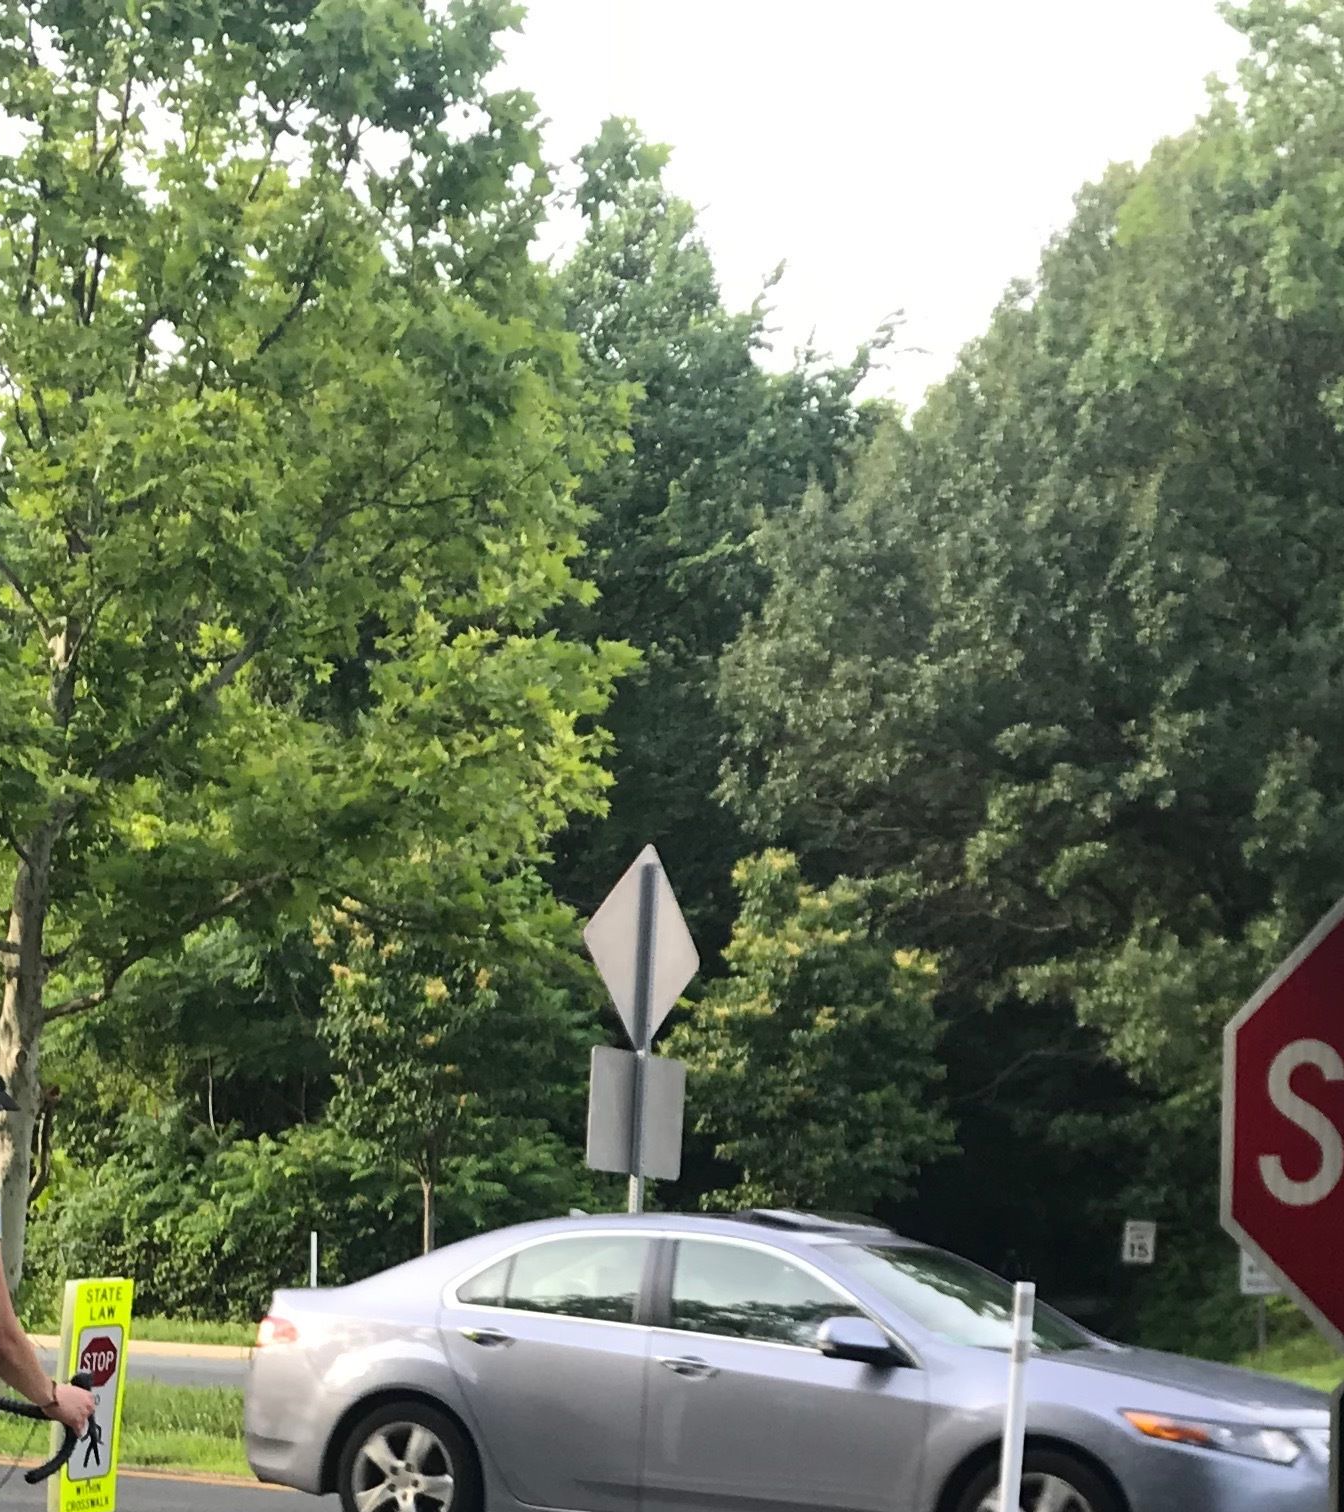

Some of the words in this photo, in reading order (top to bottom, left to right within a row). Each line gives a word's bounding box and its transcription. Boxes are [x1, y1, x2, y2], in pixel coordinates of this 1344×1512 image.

[1129, 1242, 1150, 1258] 15
[86, 1286, 123, 1303] STATE
[89, 1306, 116, 1321] LAW
[82, 1350, 115, 1373] STOP
